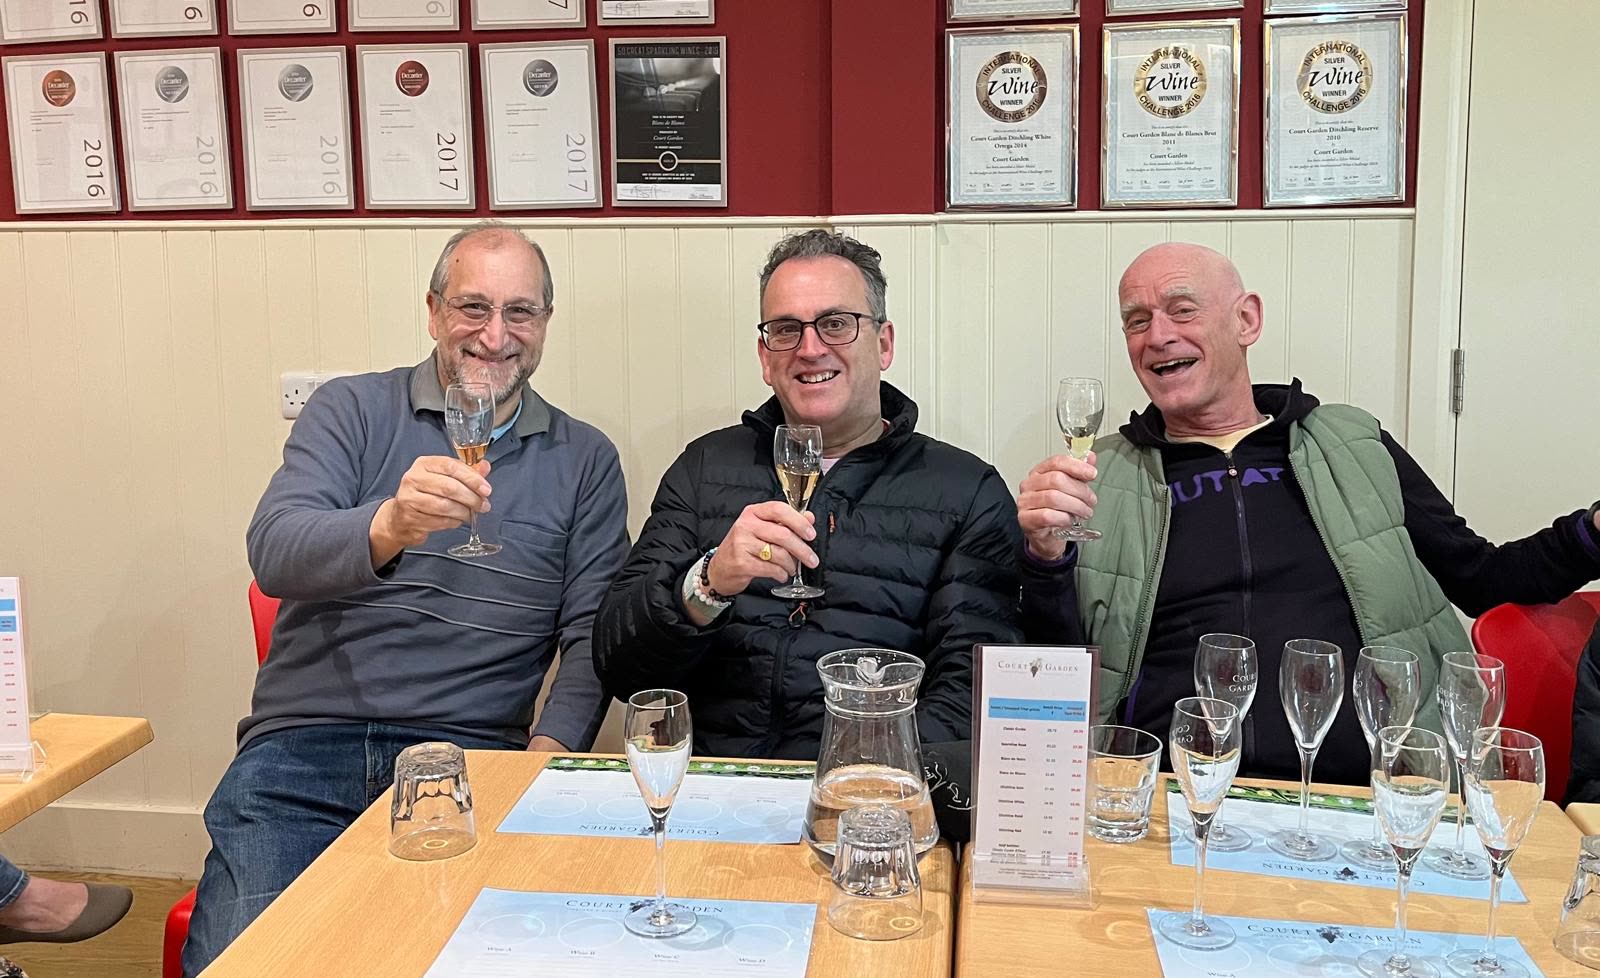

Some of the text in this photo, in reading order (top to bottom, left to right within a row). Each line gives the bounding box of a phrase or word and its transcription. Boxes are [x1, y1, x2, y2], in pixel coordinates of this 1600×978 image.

[983, 52, 1040, 76] INTERNATIONAL
[1140, 49, 1200, 71] INTERNATIONAL
[1303, 43, 1366, 67] INTERNATIONAL
[988, 77, 1039, 95] Wine
[1146, 72, 1200, 92] Wine
[1309, 66, 1364, 87] Wine
[1140, 93, 1201, 116] CHALLENGE 2016
[1302, 88, 1366, 112] CHALLENGE 2016
[1322, 89, 1347, 97] WINNER
[981, 100, 1028, 120] CHALLENGE
[84, 139, 105, 197] 2016
[196, 136, 218, 194] 2016
[320, 135, 342, 194] 2016
[436, 132, 458, 191] 2017
[565, 132, 588, 193] 2017
[1171, 470, 1227, 507] UT
[998, 660, 1079, 672] COURT GARDEN
[578, 824, 639, 833] GARDEN
[1262, 862, 1425, 887] CURT GARDEN
[566, 899, 624, 909] COURT
[1247, 924, 1311, 936] COURT
